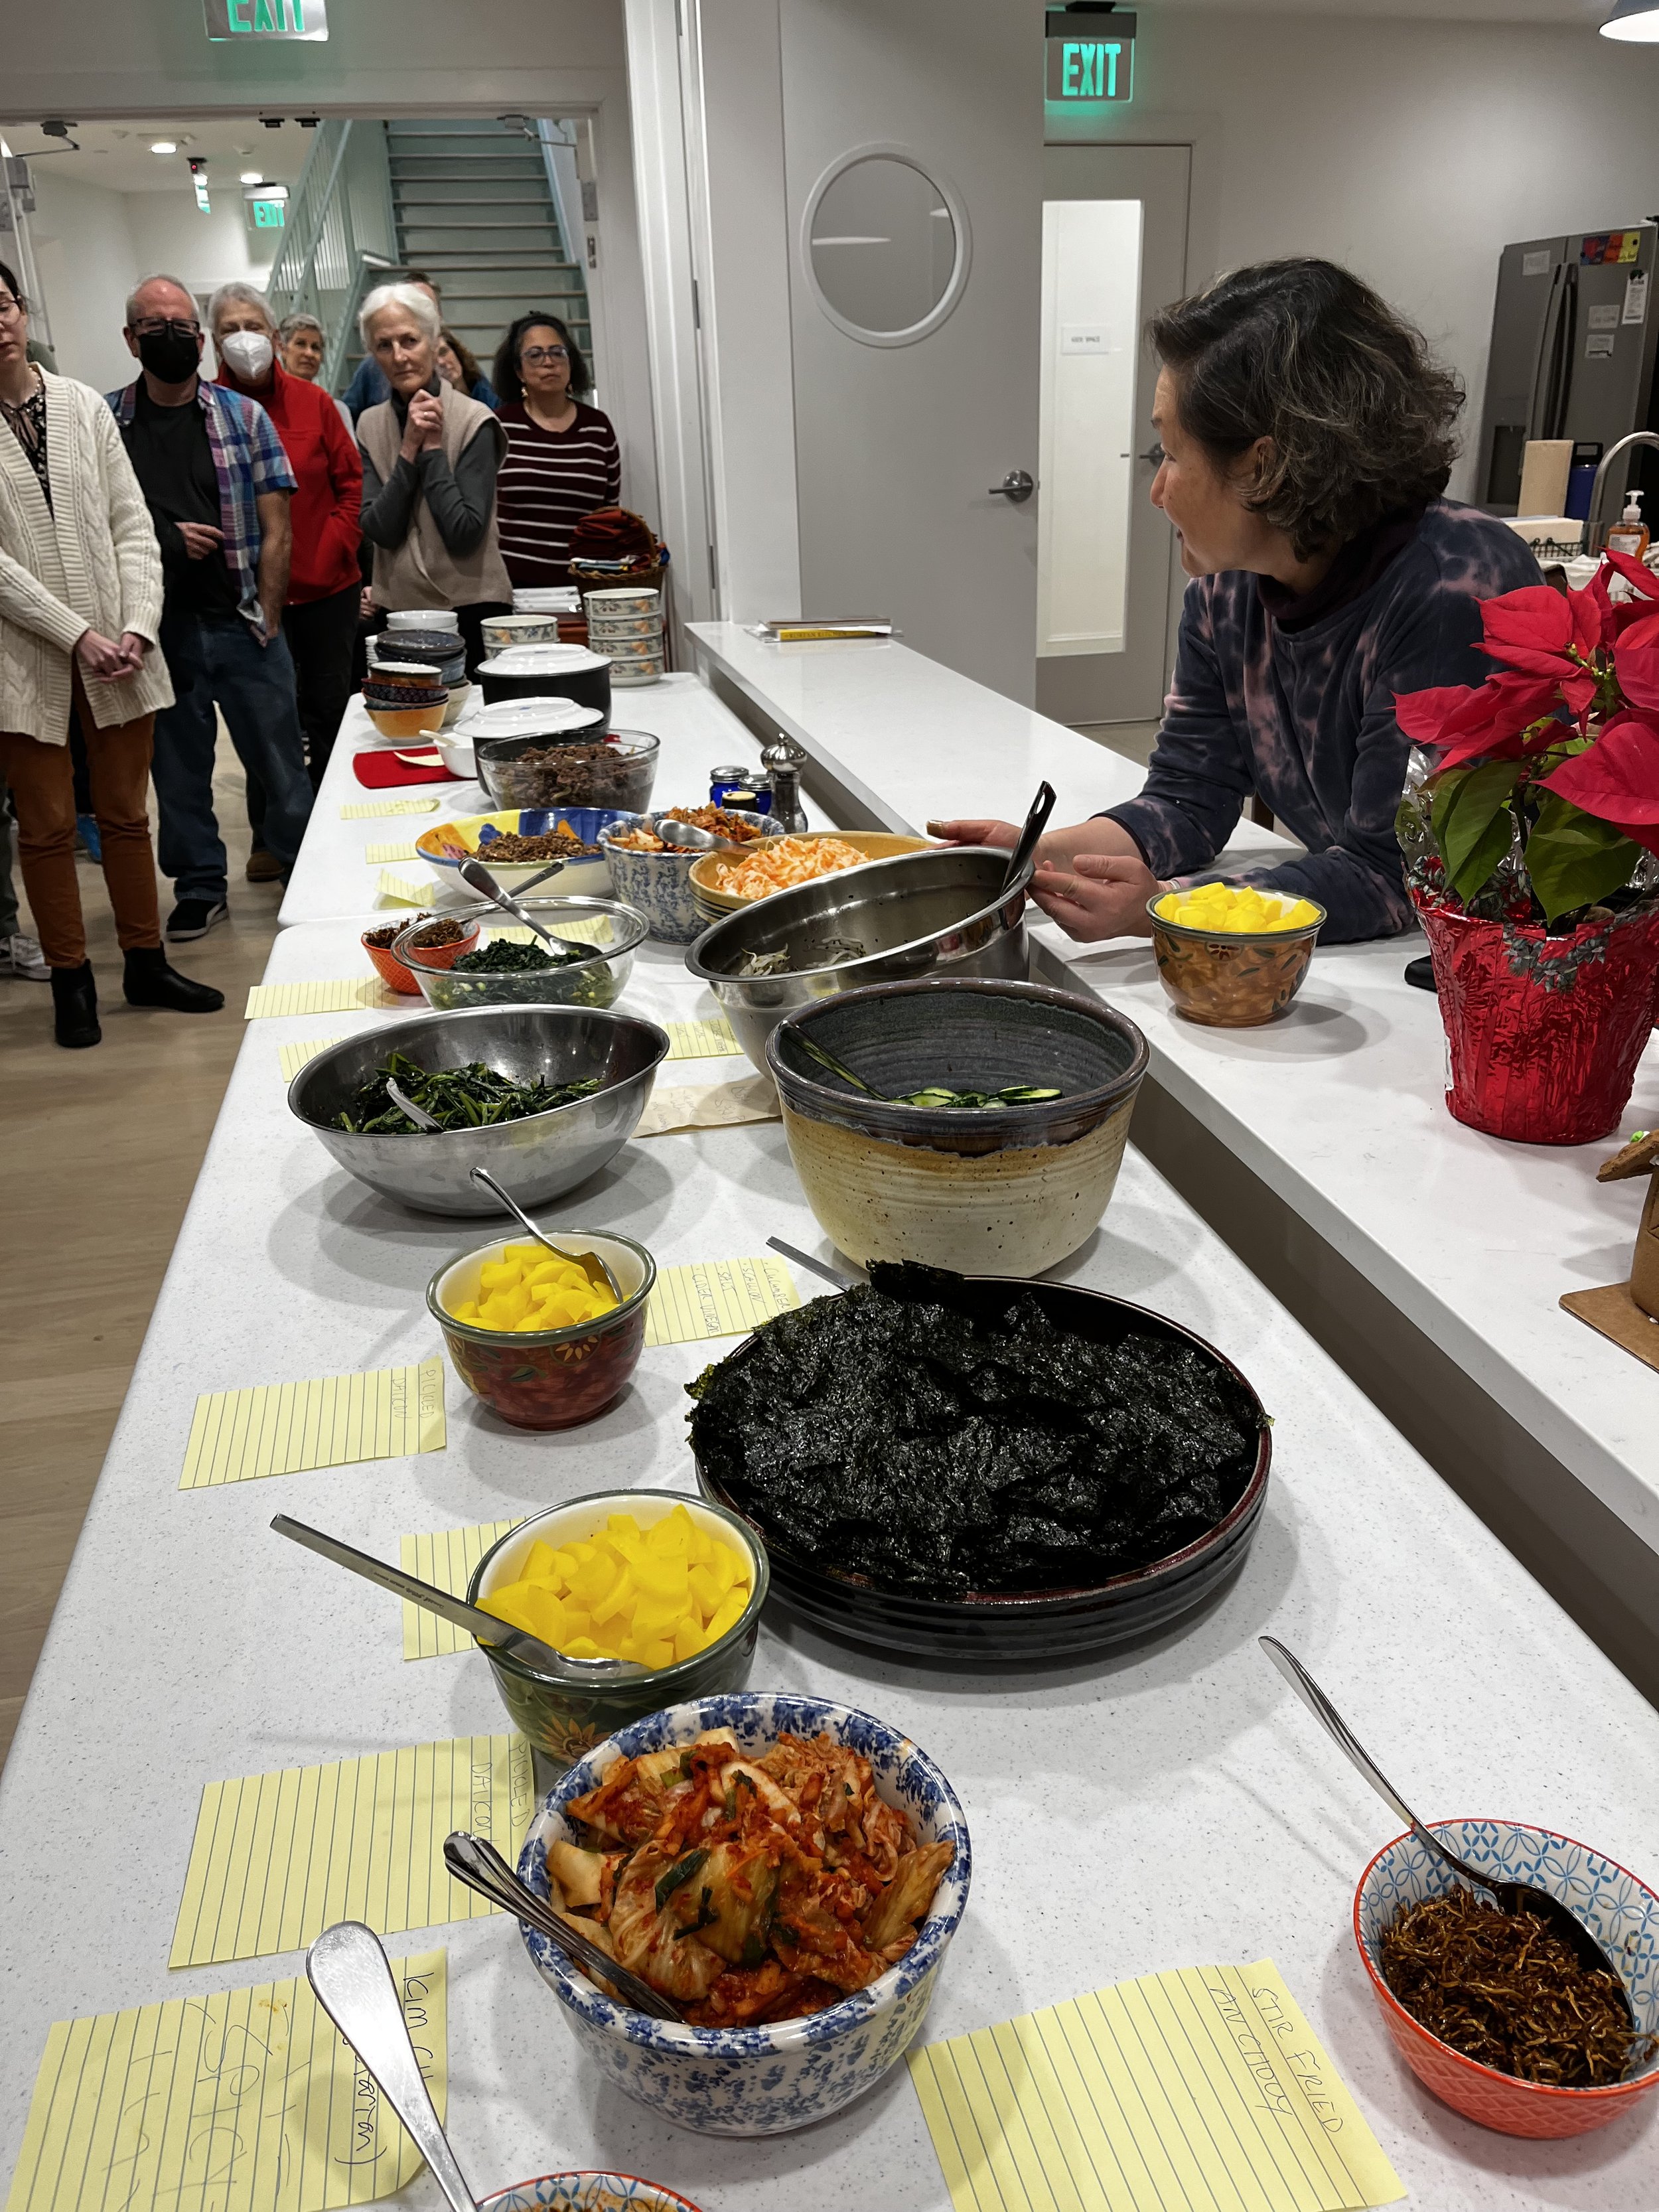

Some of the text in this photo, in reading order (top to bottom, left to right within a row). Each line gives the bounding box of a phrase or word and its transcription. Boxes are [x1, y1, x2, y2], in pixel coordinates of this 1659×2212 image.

[1062, 43, 1121, 96] EXIT
[419, 1369, 436, 1418] PICKLED
[471, 1763, 500, 1842] DAIKON
[509, 1740, 530, 1827] PICKLED
[1252, 1986, 1344, 2134] STIR FRIED
